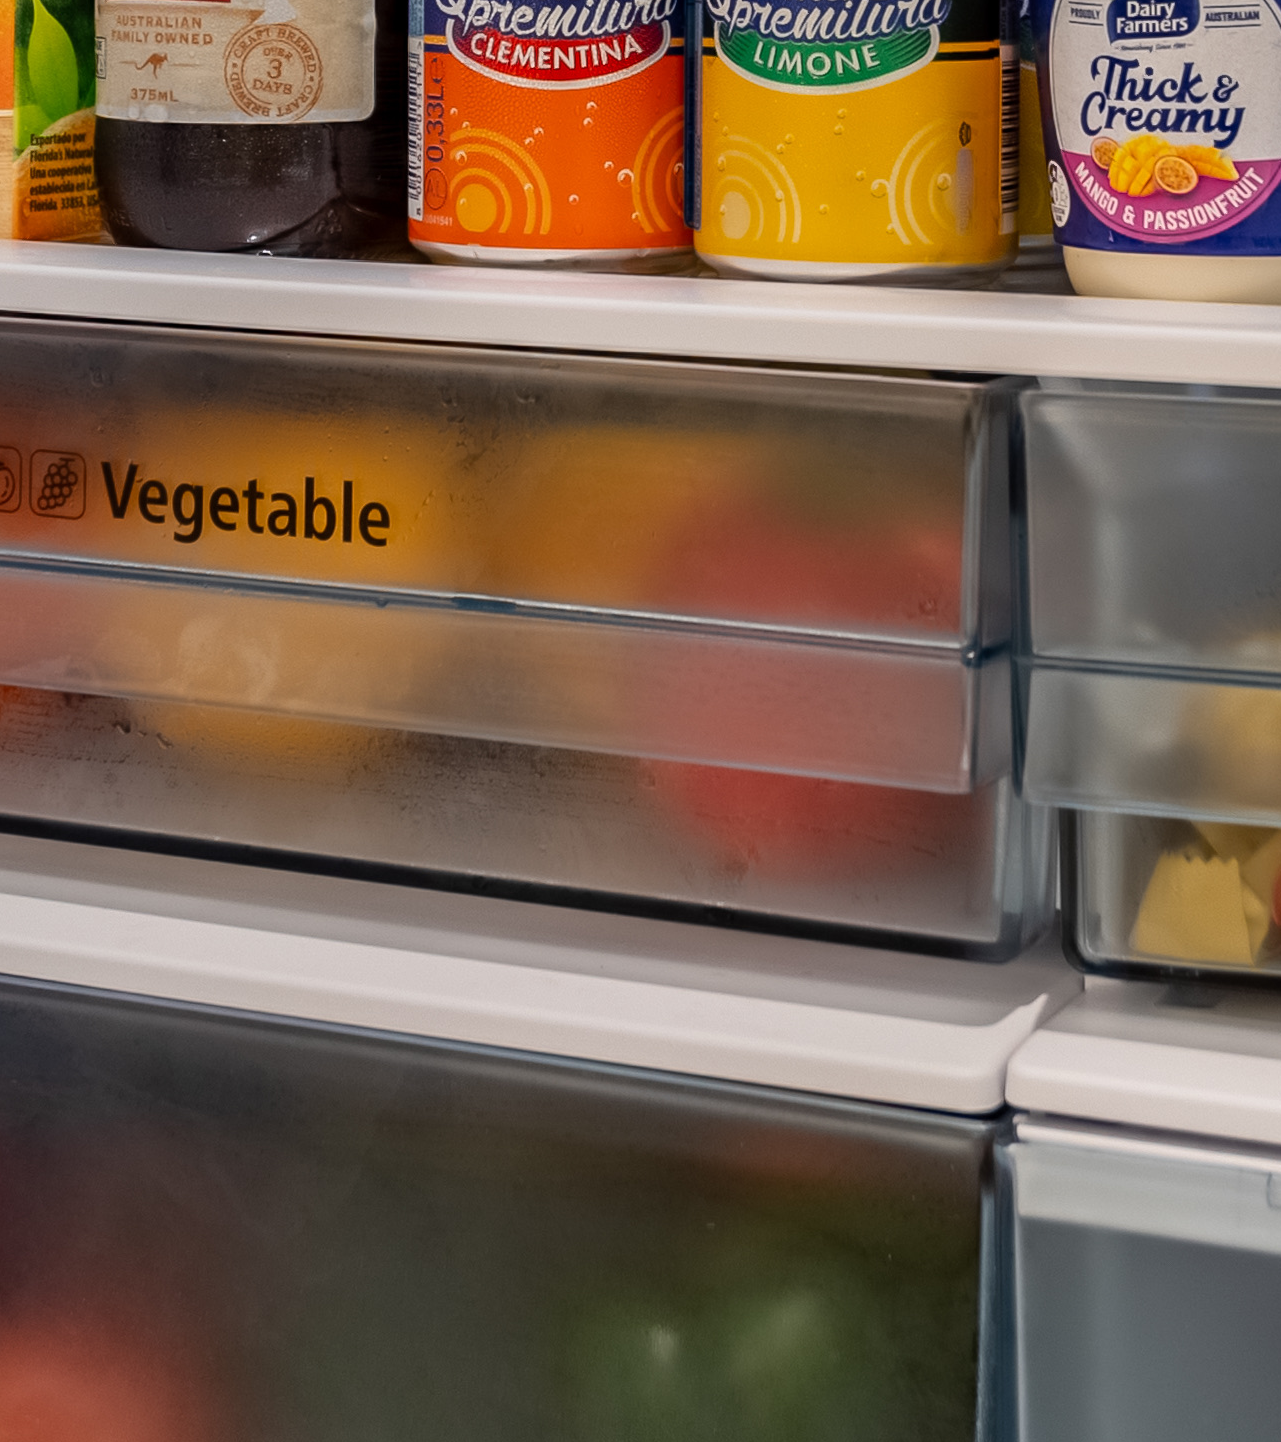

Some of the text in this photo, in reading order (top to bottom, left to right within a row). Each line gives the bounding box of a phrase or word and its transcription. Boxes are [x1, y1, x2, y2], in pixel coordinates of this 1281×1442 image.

[1070, 7, 1101, 20] PROUDLY
[1126, 0, 1176, 18] Dairy
[1205, 11, 1260, 22] AUSTRALIAN
[117, 15, 203, 30] AUSTRALIAN
[1116, 17, 1189, 34] Farmers
[111, 30, 214, 45] FAMILY OWNED
[234, 28, 317, 73] CRAFT BREWED
[263, 47, 293, 62] OVER
[470, 31, 645, 70] CLEMENTINA
[753, 41, 881, 78] LIMONE
[266, 58, 283, 79] 3
[252, 77, 293, 95] DAYS
[1089, 54, 1240, 104] Thick &
[230, 72, 314, 117] BREWED CRAFT
[1080, 90, 1246, 149] Creamy
[30, 132, 87, 148] Exportado por
[30, 146, 94, 163] Florida's Natural
[30, 162, 93, 179] Una cooperativa
[30, 180, 86, 196] establecida en
[1074, 161, 1266, 231] MANGO & PASSIONFRUIT
[101, 460, 392, 548] Vegetable
